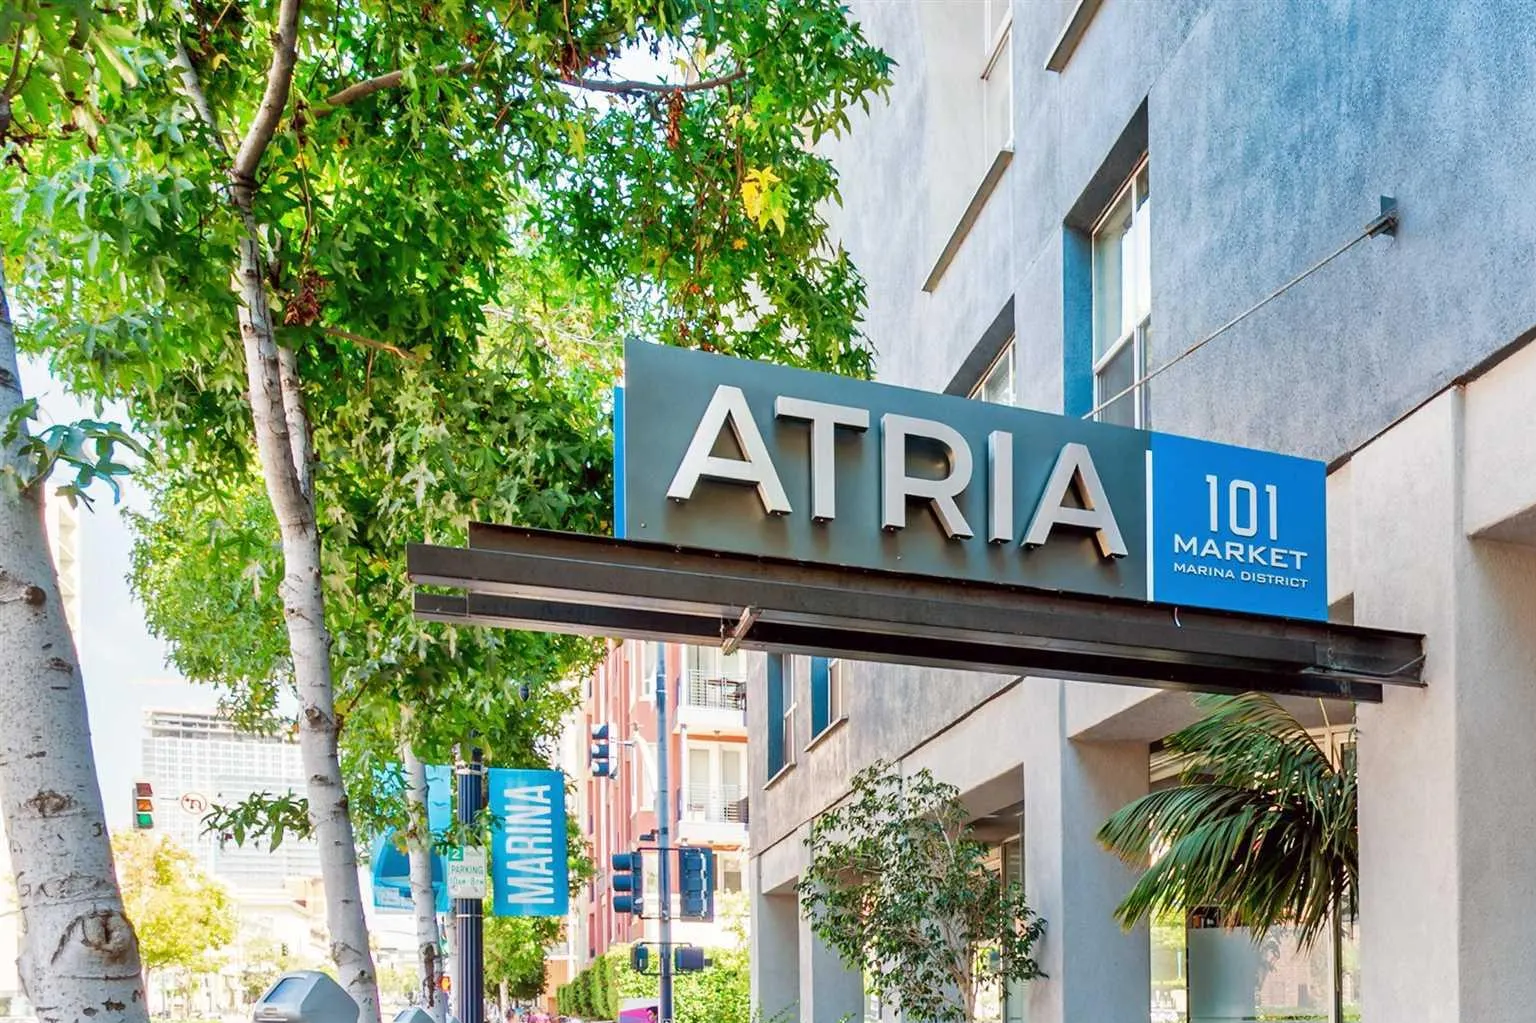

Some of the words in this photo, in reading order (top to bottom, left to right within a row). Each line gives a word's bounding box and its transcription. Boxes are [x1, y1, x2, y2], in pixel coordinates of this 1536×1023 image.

[666, 384, 1129, 560] ATRIA
[1205, 474, 1278, 541] 101
[1173, 533, 1308, 570] MARKET
[1173, 562, 1236, 580] MARINA
[1240, 570, 1309, 589] DISTRICT
[503, 784, 555, 904] MARINA
